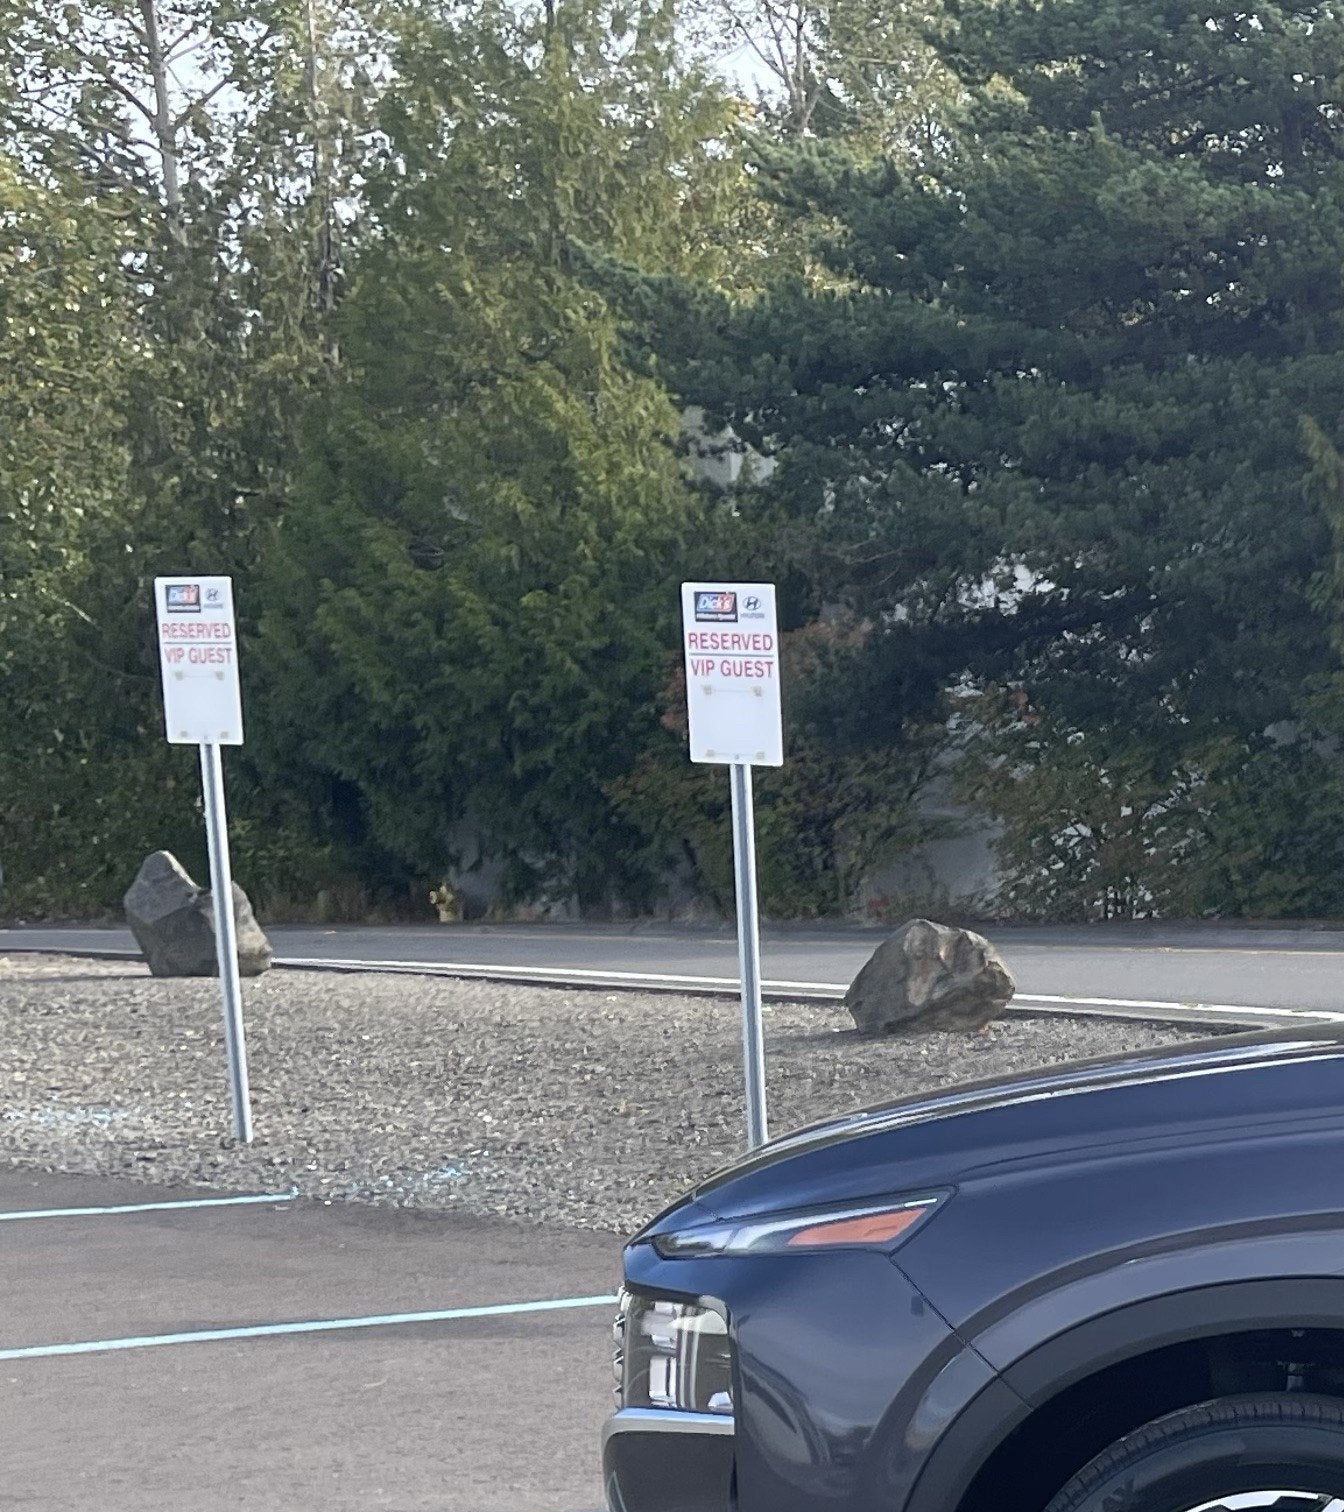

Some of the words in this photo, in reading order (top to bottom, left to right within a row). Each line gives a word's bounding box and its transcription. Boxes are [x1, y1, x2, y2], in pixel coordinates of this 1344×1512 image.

[162, 622, 232, 640] RESERVED
[688, 632, 773, 651] RESERVED
[164, 647, 185, 664] VIP
[188, 647, 232, 664] GUEST
[690, 659, 715, 676] VIP
[720, 660, 774, 678] GUEST
